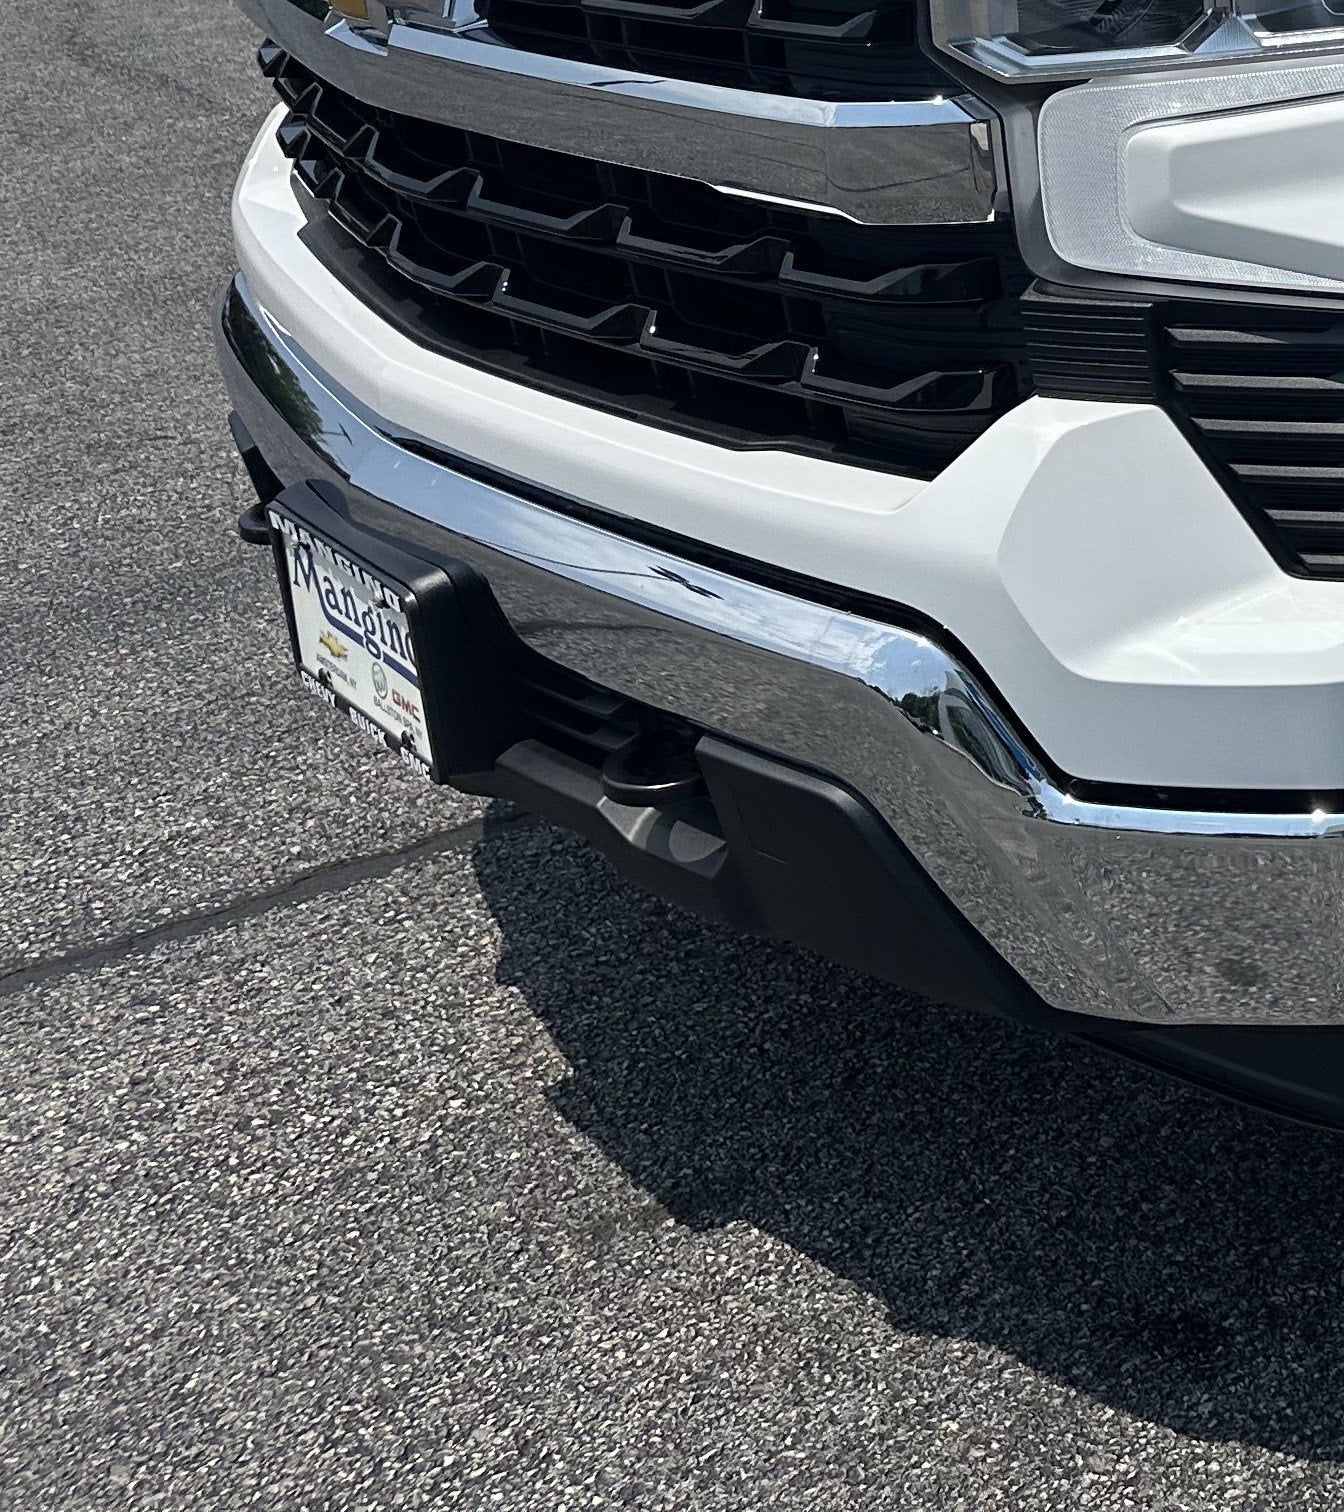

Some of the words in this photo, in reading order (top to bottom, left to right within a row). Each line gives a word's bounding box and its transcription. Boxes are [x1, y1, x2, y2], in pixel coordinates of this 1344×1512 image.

[269, 510, 401, 613] MANGINO
[300, 670, 336, 708] CHEVY
[349, 707, 388, 748] BUICK
[400, 746, 431, 781] GMC
[391, 688, 420, 723] GMC
